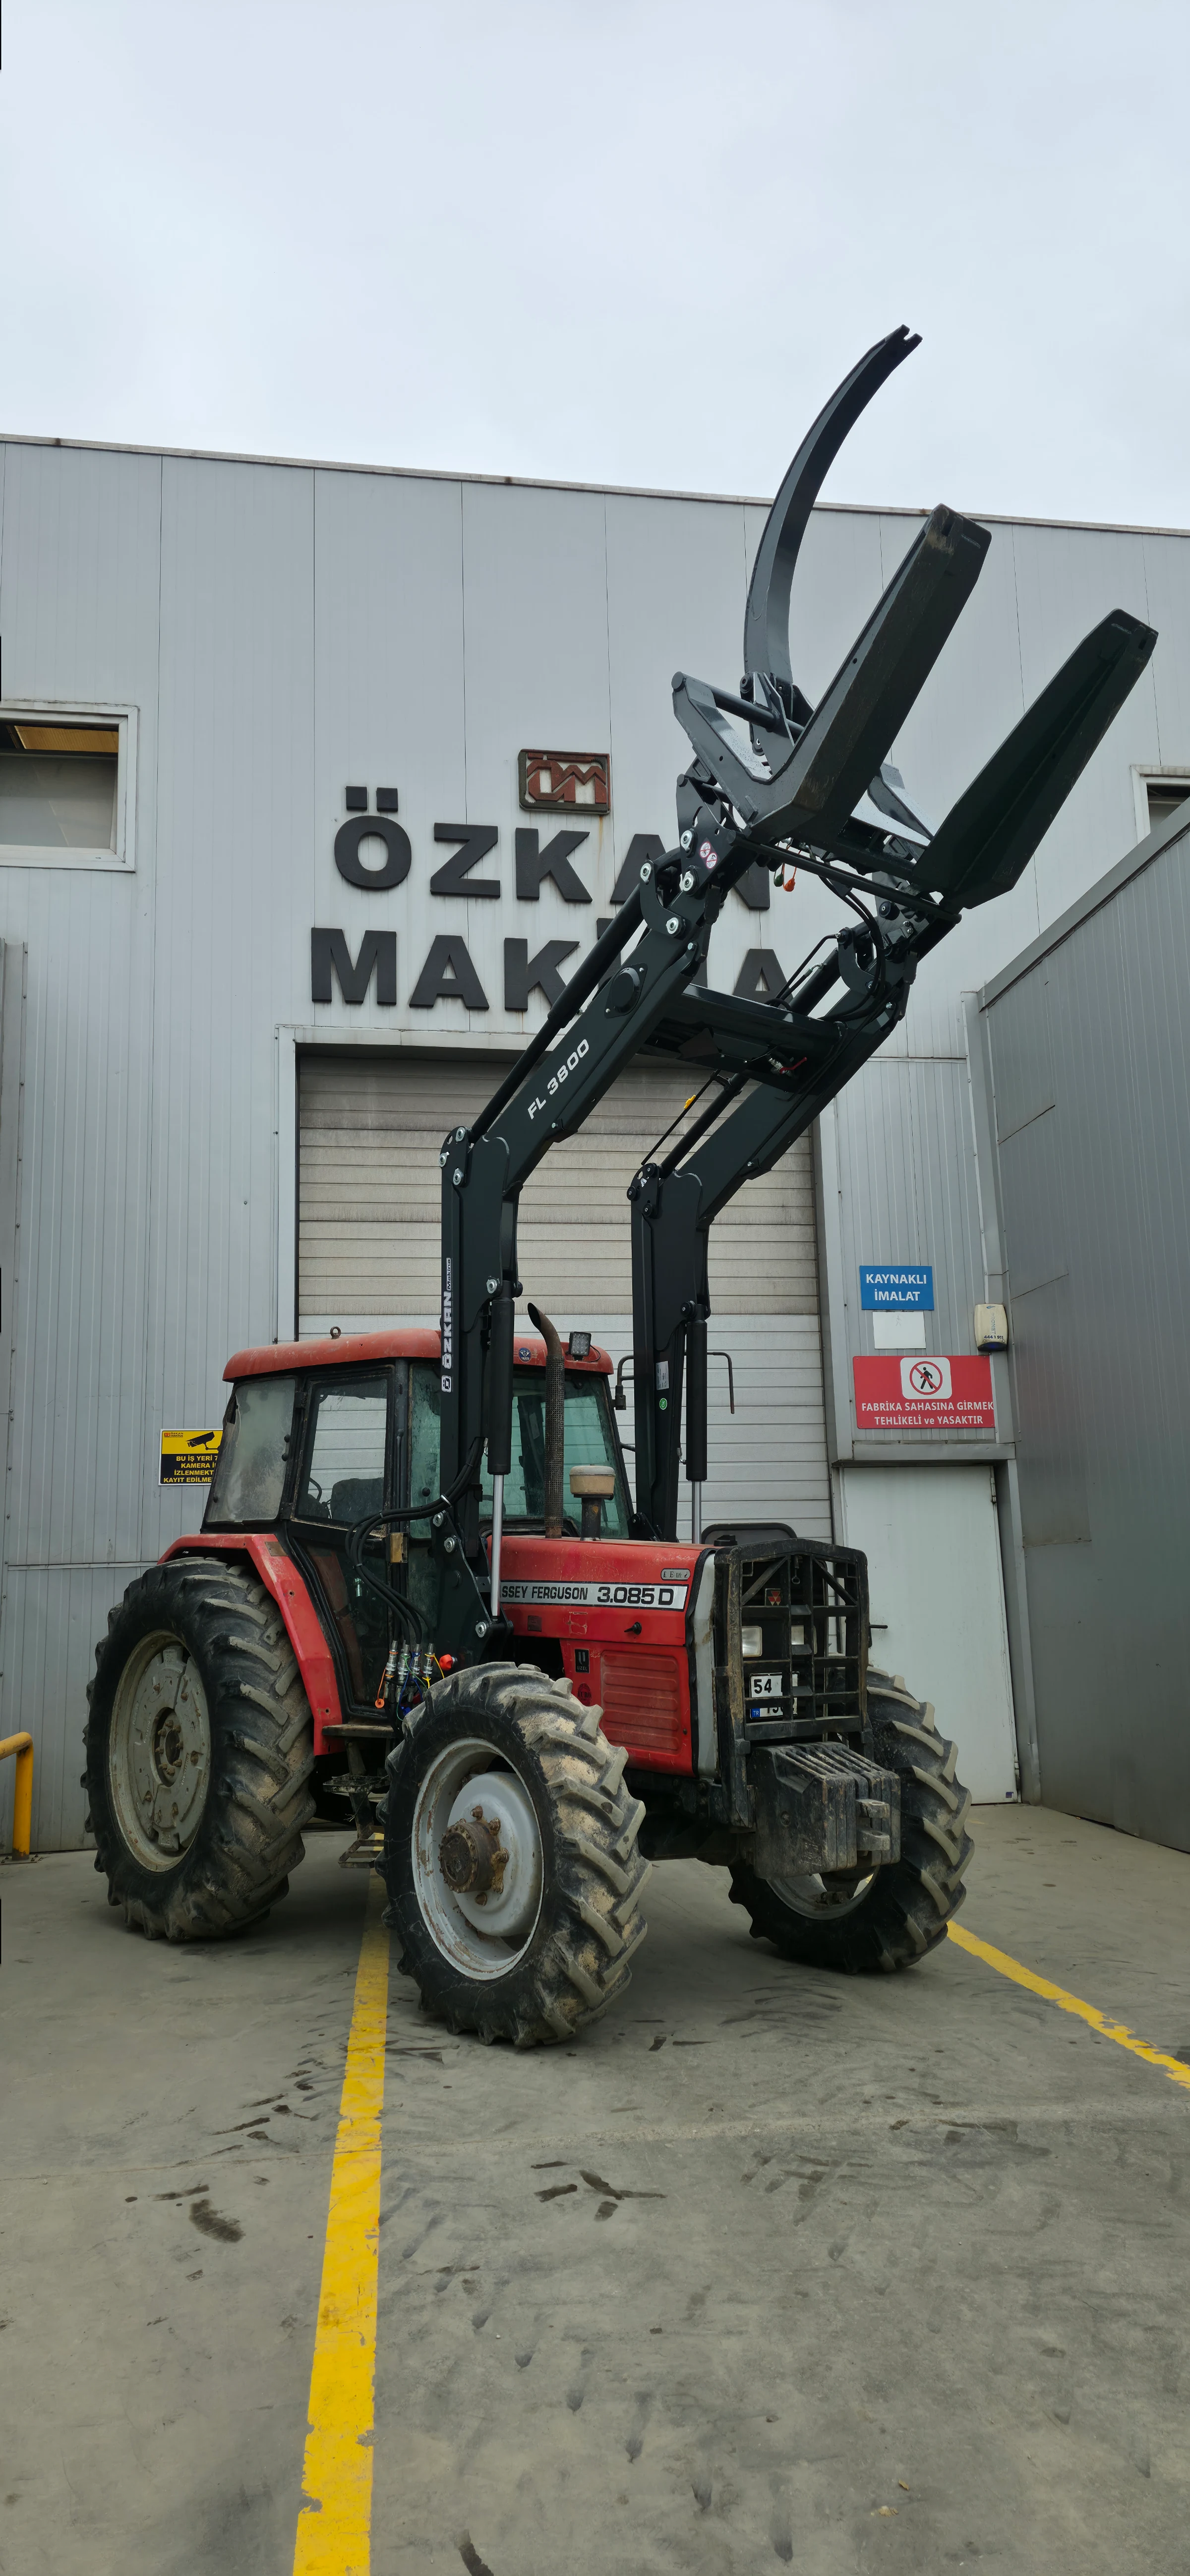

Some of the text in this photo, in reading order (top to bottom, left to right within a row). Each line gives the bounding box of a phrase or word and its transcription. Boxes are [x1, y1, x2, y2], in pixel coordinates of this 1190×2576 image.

[334, 786, 770, 910] ÖZKA
[311, 918, 792, 1011] MAKA
[528, 1038, 590, 1119] FL 3800
[866, 1274, 927, 1284] KAYNAKLI
[874, 1289, 920, 1301] İMALAT
[442, 1291, 452, 1369] ÖZKAN
[862, 1400, 994, 1412] FABRİKA SAHASINA GİRMEK
[875, 1414, 922, 1425] TEHLİKELİ
[937, 1416, 983, 1425] YASAKTIR
[501, 1586, 674, 1605] SSEY FERGUSON 3.085 D
[754, 1678, 772, 1694] 54
